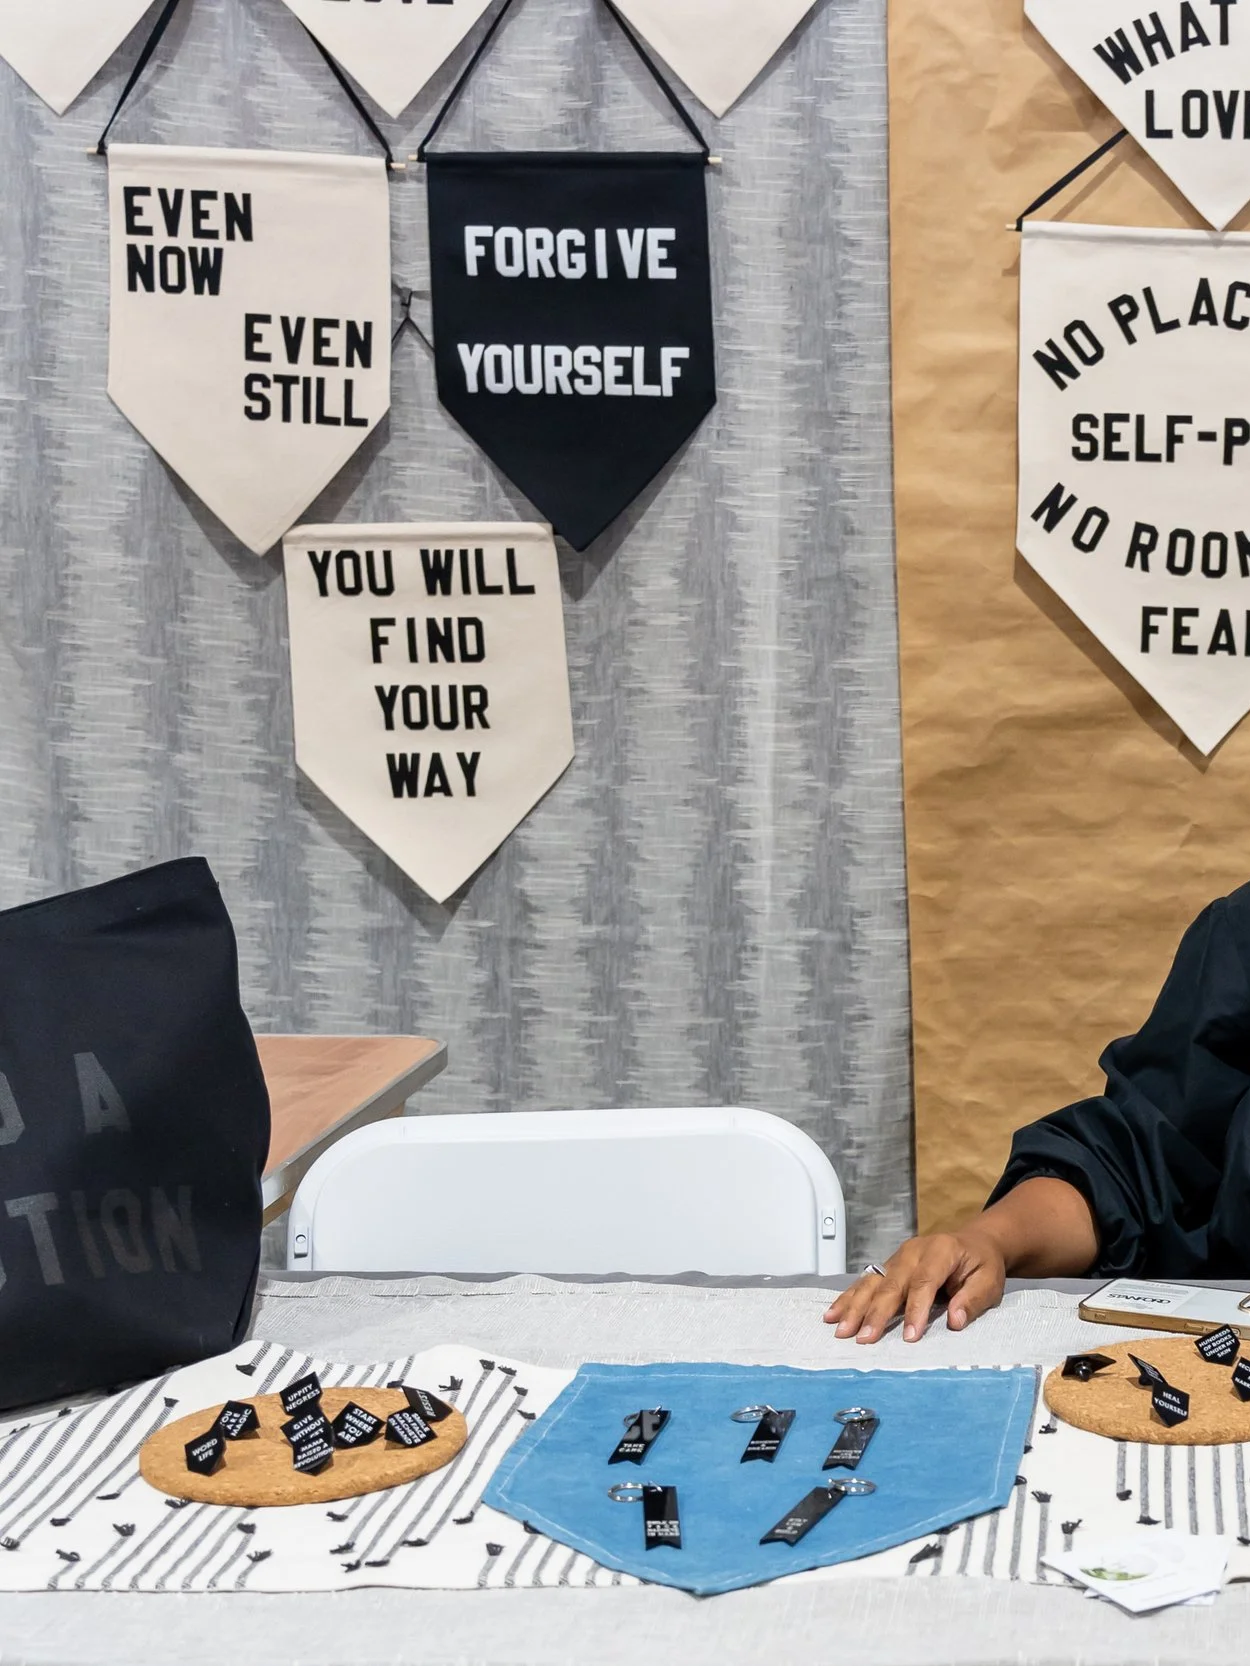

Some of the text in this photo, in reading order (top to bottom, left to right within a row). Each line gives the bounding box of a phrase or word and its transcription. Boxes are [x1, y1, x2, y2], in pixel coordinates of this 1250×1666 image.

[1093, 0, 1236, 84] WHAT
[124, 187, 252, 241] EVEN
[465, 226, 676, 279] FORGIVE
[127, 244, 223, 295] NOW
[245, 313, 372, 368] EVEN
[1033, 320, 1104, 390] NO
[458, 344, 689, 396] YOURSELF
[245, 373, 368, 427] STILL
[1031, 483, 1109, 553] NO
[308, 548, 535, 597] YOU WILL
[370, 617, 485, 663] FIND
[375, 685, 490, 730] YOUR
[386, 752, 480, 798] WAY
[73, 1051, 131, 1133] A
[0, 1184, 201, 1286] TION
[1198, 1328, 1231, 1348] HUNDREDS
[1205, 1338, 1236, 1357] UNDER MY
[1212, 1334, 1233, 1347] BOOKS
[1216, 1347, 1232, 1358] SKIN
[285, 1388, 321, 1412] NEGRESS
[287, 1383, 313, 1402] UPPITY
[1162, 1391, 1181, 1405] HEAL
[352, 1407, 378, 1425] START
[1153, 1396, 1188, 1417] YOURSELF
[226, 1412, 241, 1431] ARE
[230, 1408, 253, 1437] MAGIC
[290, 1416, 325, 1442] WITHOUT
[292, 1414, 314, 1430] GIVE
[344, 1422, 363, 1438] YOU
[345, 1412, 374, 1434] WHERE
[192, 1438, 218, 1457] WORD
[337, 1430, 357, 1444] ARE
[198, 1448, 214, 1462] LIFE
